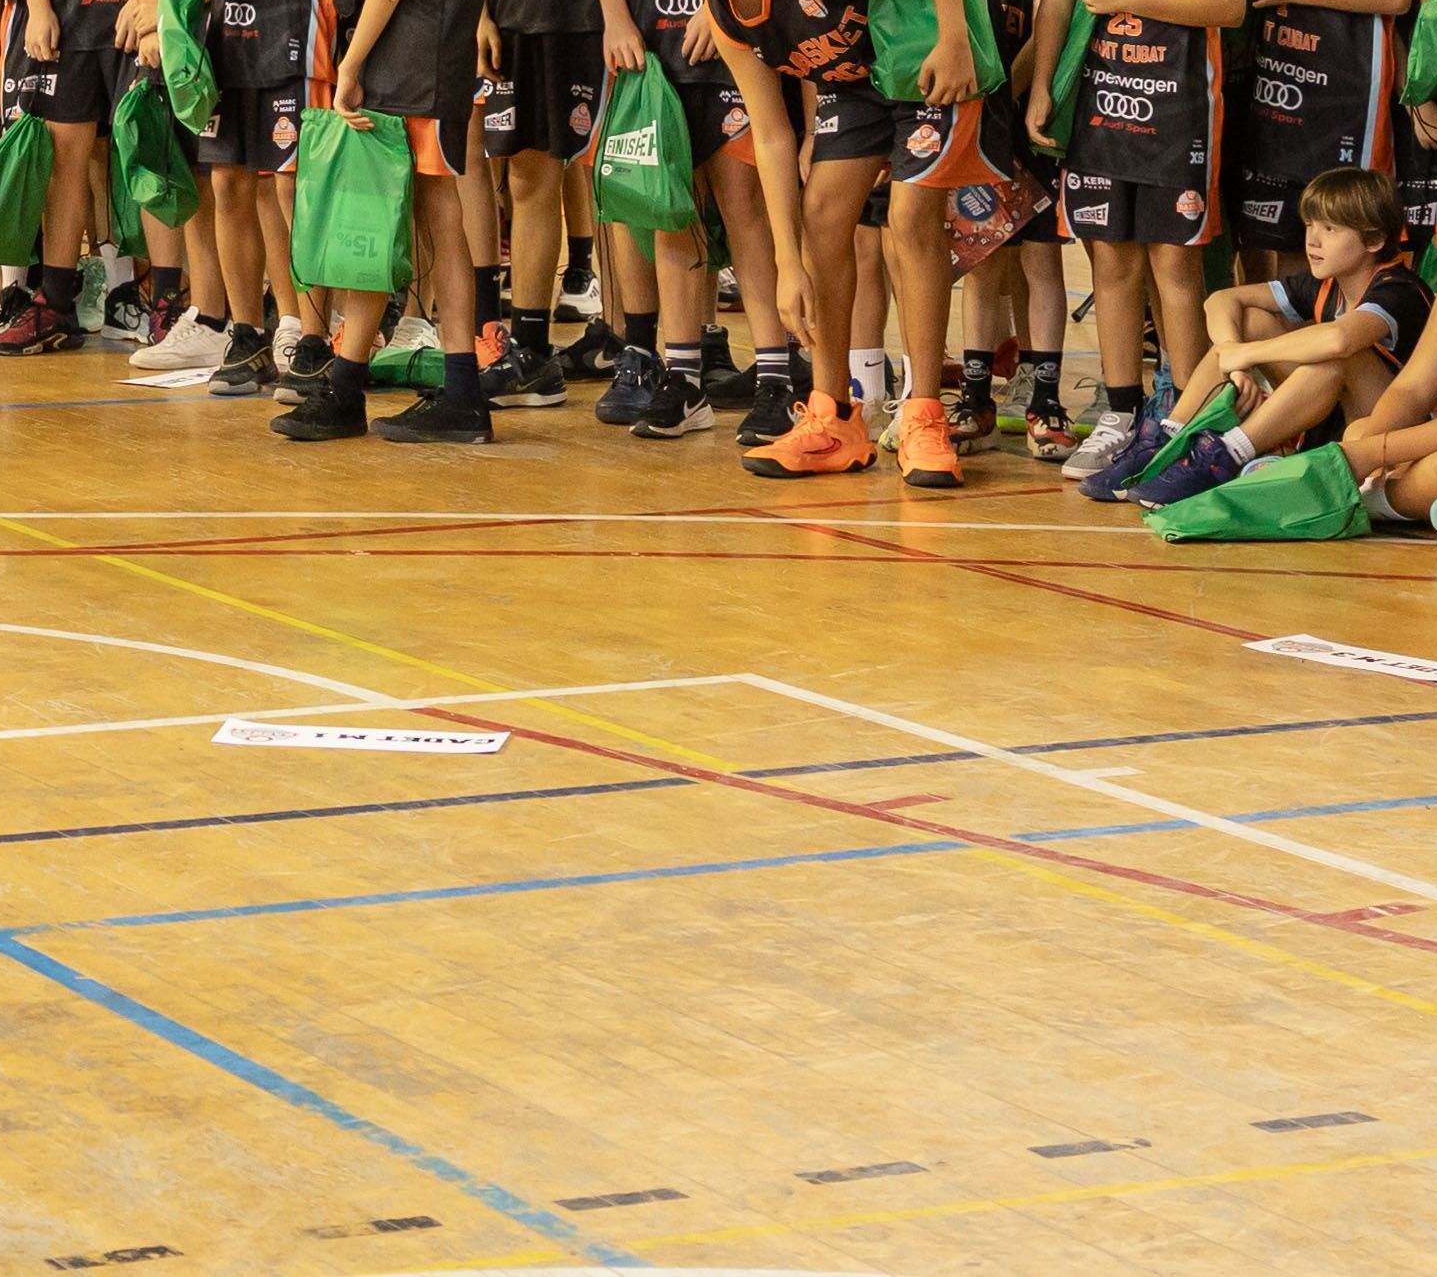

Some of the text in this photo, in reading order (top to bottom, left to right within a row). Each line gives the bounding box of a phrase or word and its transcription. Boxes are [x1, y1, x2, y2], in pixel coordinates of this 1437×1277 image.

[1107, 11, 1143, 38] 25
[1122, 44, 1167, 64] CUGAT
[1124, 120, 1157, 136] Sport
[1190, 151, 1205, 165] XS
[1339, 148, 1353, 163] M
[1083, 175, 1112, 186] KERN
